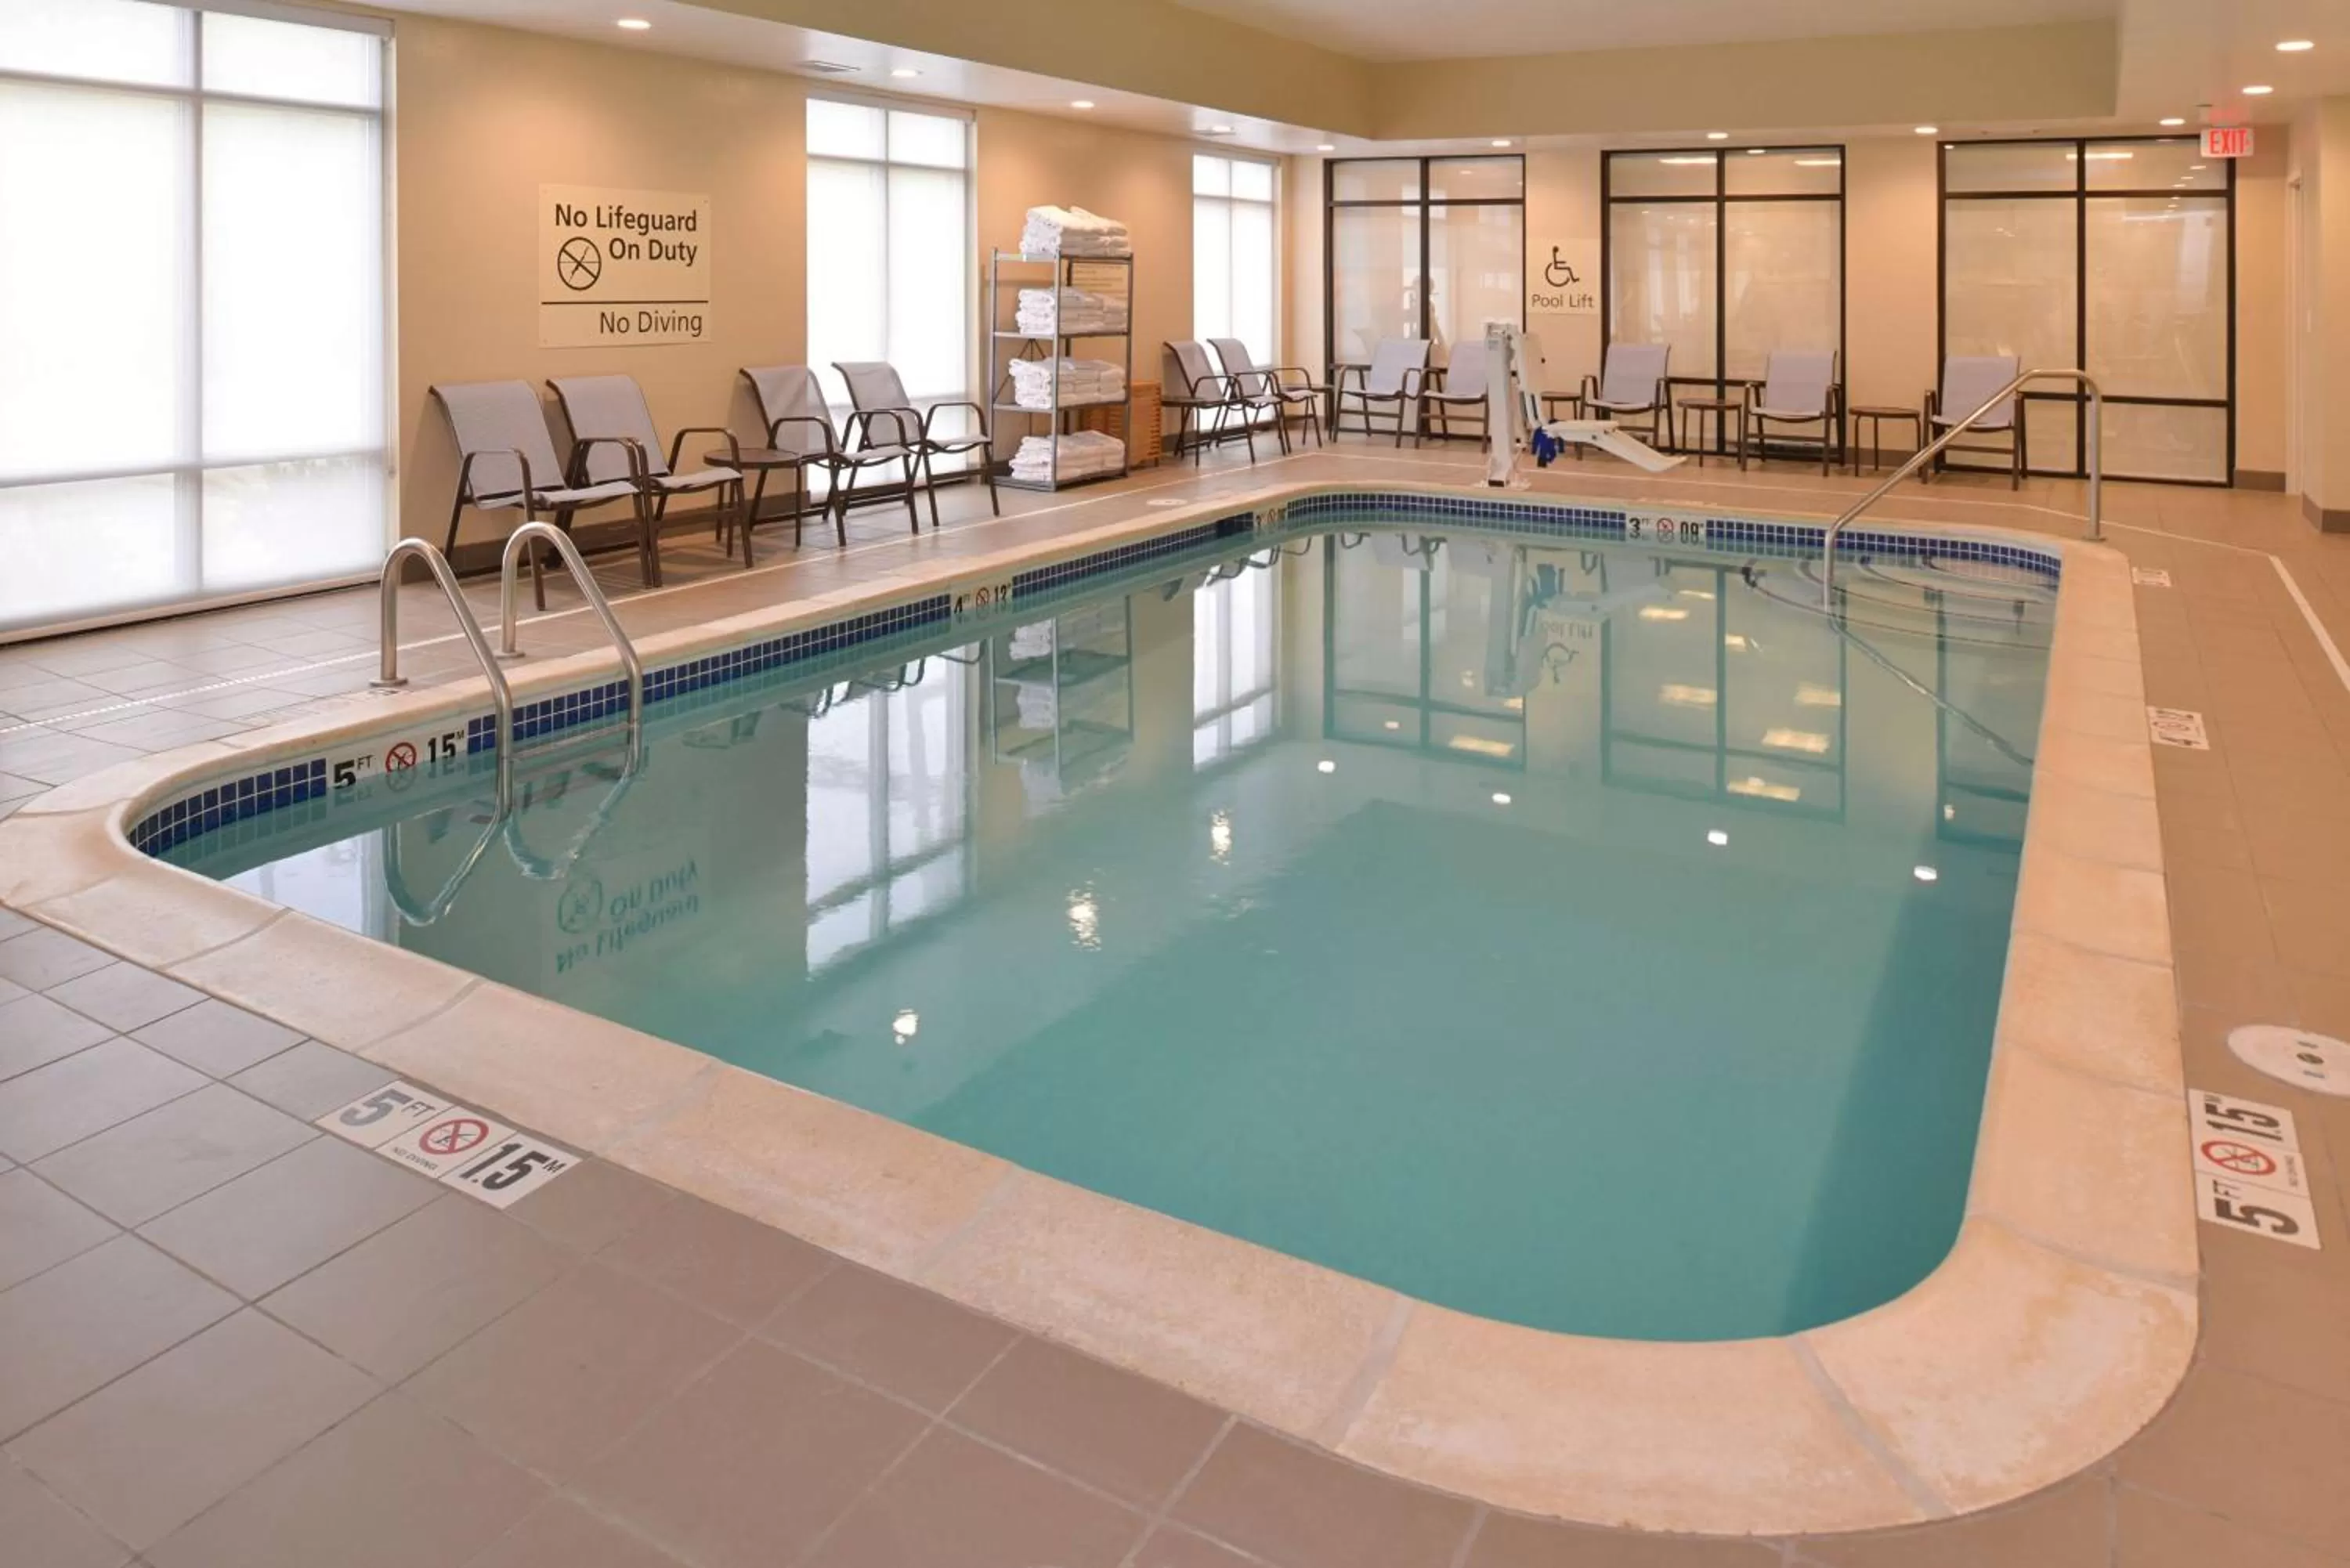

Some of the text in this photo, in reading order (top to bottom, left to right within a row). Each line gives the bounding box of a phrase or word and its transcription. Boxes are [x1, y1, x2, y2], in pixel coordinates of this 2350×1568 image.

[2210, 130, 2246, 154] EXIT
[555, 204, 697, 236] No Lifeguard
[609, 238, 697, 267] On Duty
[1531, 294, 1594, 308] Pool Lift
[600, 310, 703, 338] No Diving
[334, 754, 373, 789] 5 FT
[339, 1089, 436, 1126] 5 FT
[2204, 1103, 2283, 1141] 1.5
[459, 1143, 567, 1190] 1.5 M
[2214, 1197, 2299, 1235] 5
